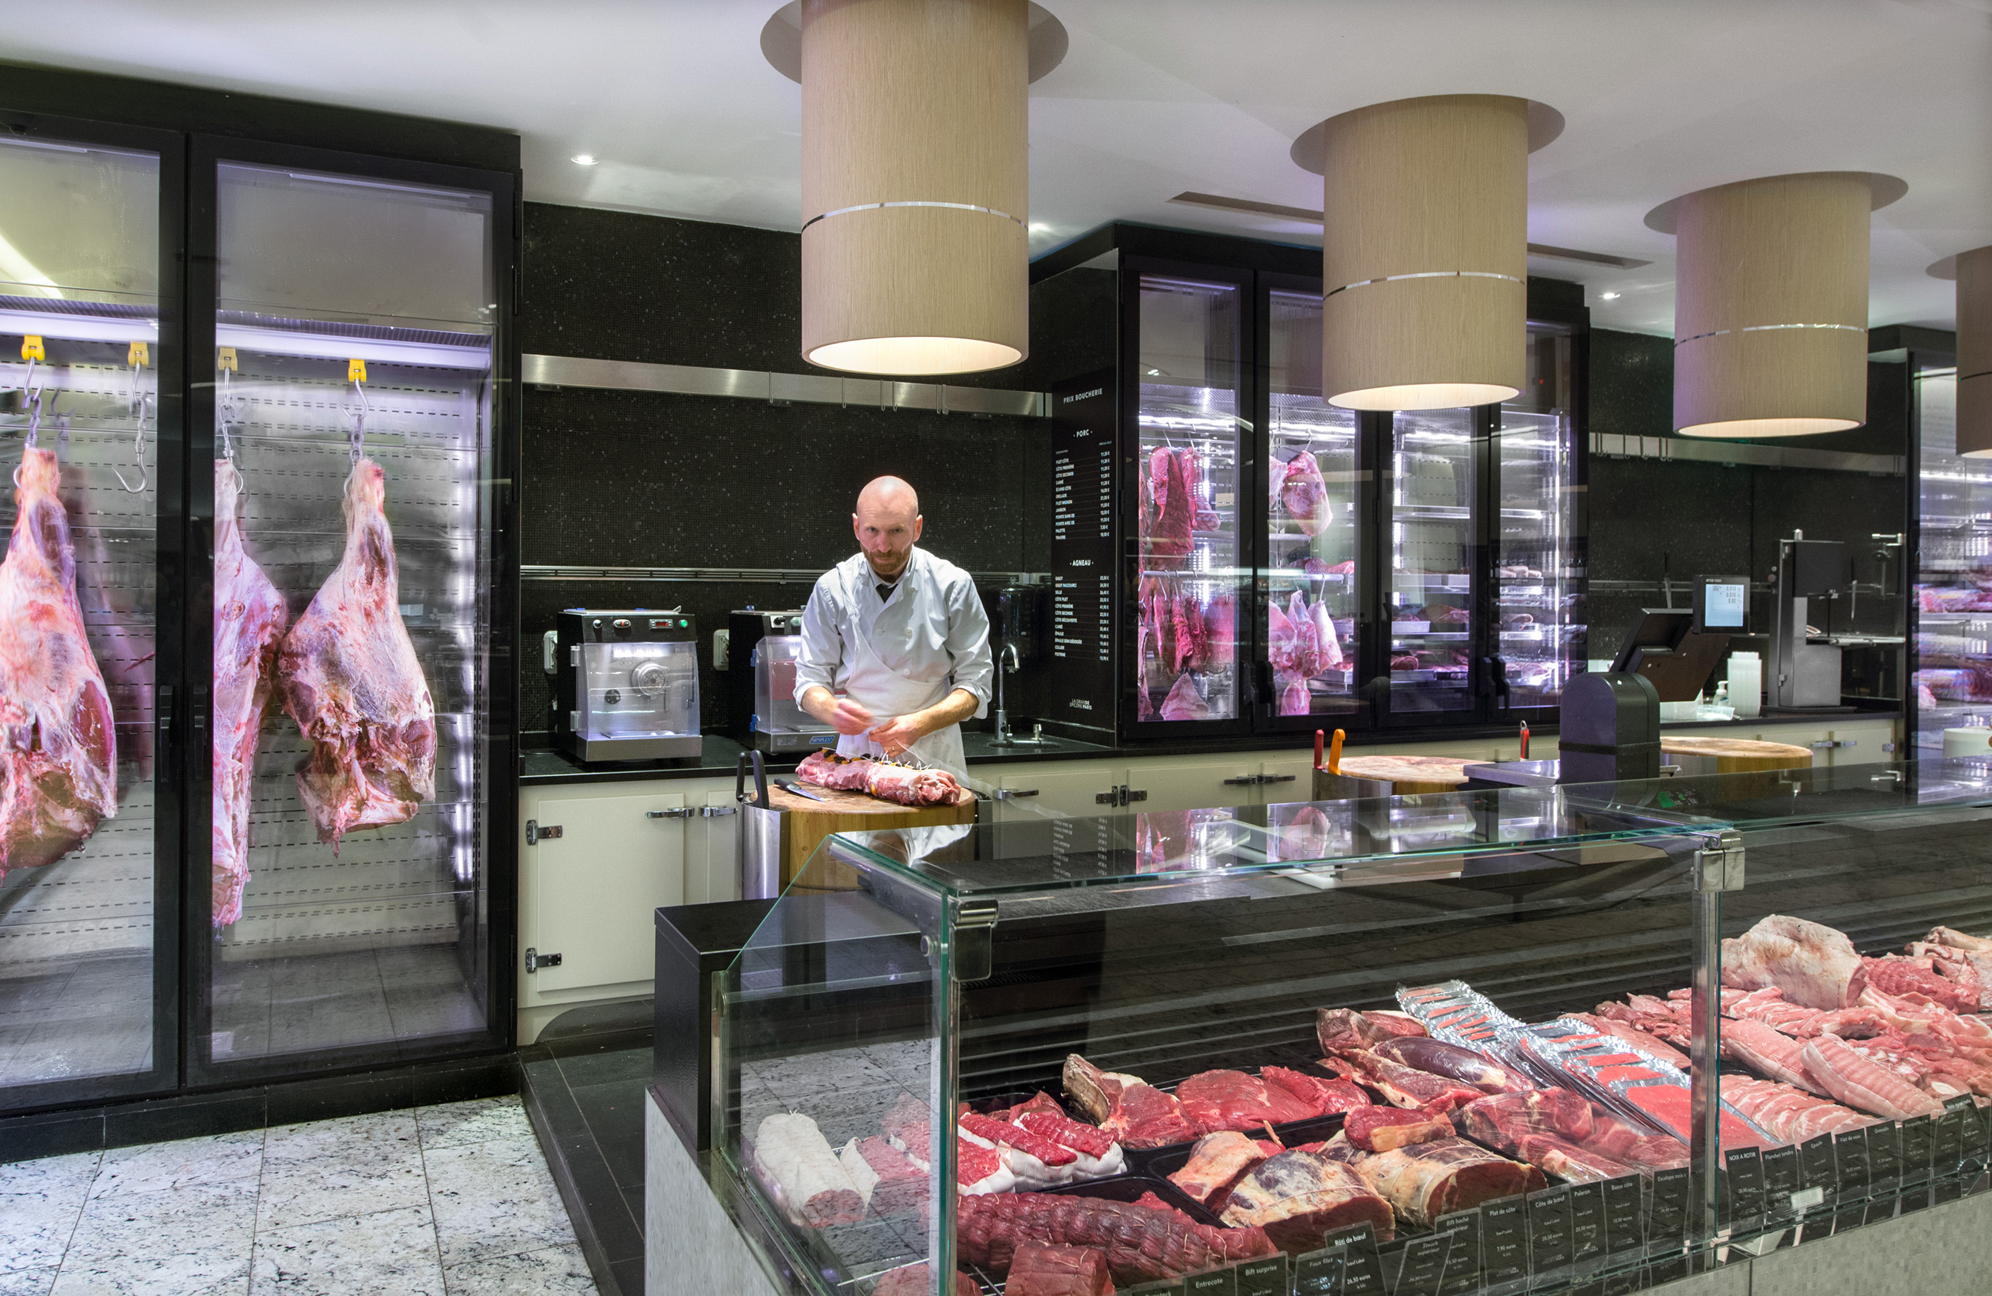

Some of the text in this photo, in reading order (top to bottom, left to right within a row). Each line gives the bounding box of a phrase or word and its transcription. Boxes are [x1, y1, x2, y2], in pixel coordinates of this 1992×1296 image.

[1063, 388, 1102, 404] PRIX BOUCHERIE
[1076, 429, 1089, 437] PORC
[1658, 1174, 1674, 1182] Escalope
[1611, 1183, 1623, 1191] Basse
[1574, 1189, 1590, 1197] Paleron
[1535, 1200, 1547, 1208] Côte
[1456, 1216, 1469, 1225] haché
[1335, 1238, 1345, 1246] Rôti
[1353, 1232, 1366, 1241] bœuf
[1256, 1265, 1277, 1274] surprise
